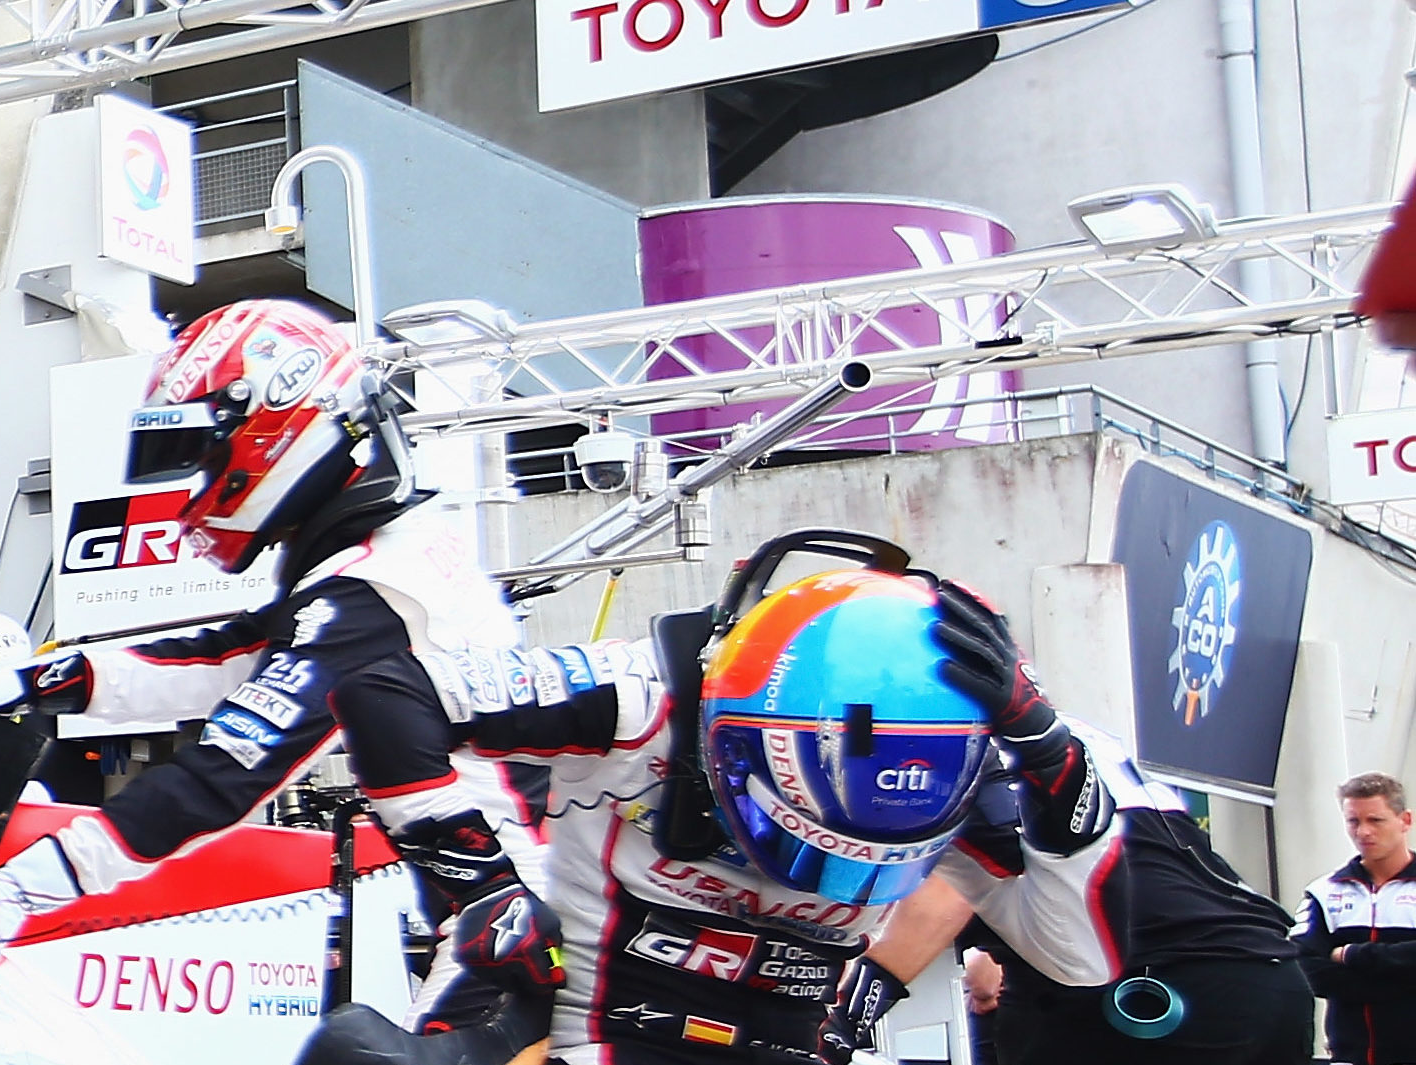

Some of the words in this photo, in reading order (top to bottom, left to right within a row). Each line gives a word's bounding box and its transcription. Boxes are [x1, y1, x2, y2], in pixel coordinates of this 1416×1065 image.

[112, 215, 183, 264] TOTAL
[169, 319, 235, 403] DENSO
[64, 519, 182, 571] GR
[76, 589, 139, 605] Pushing
[148, 583, 174, 597] the
[182, 578, 230, 594] limits
[240, 574, 266, 588] for
[764, 652, 797, 712] kimoa
[217, 711, 275, 744] AISIN
[768, 733, 817, 820] DENS
[875, 766, 930, 791] citi
[768, 803, 874, 862] TOYOTA
[248, 961, 318, 989] TOYOTA
[633, 931, 742, 981] GR
[75, 951, 235, 1016] DENSO
[247, 992, 319, 1018] HYBRID
